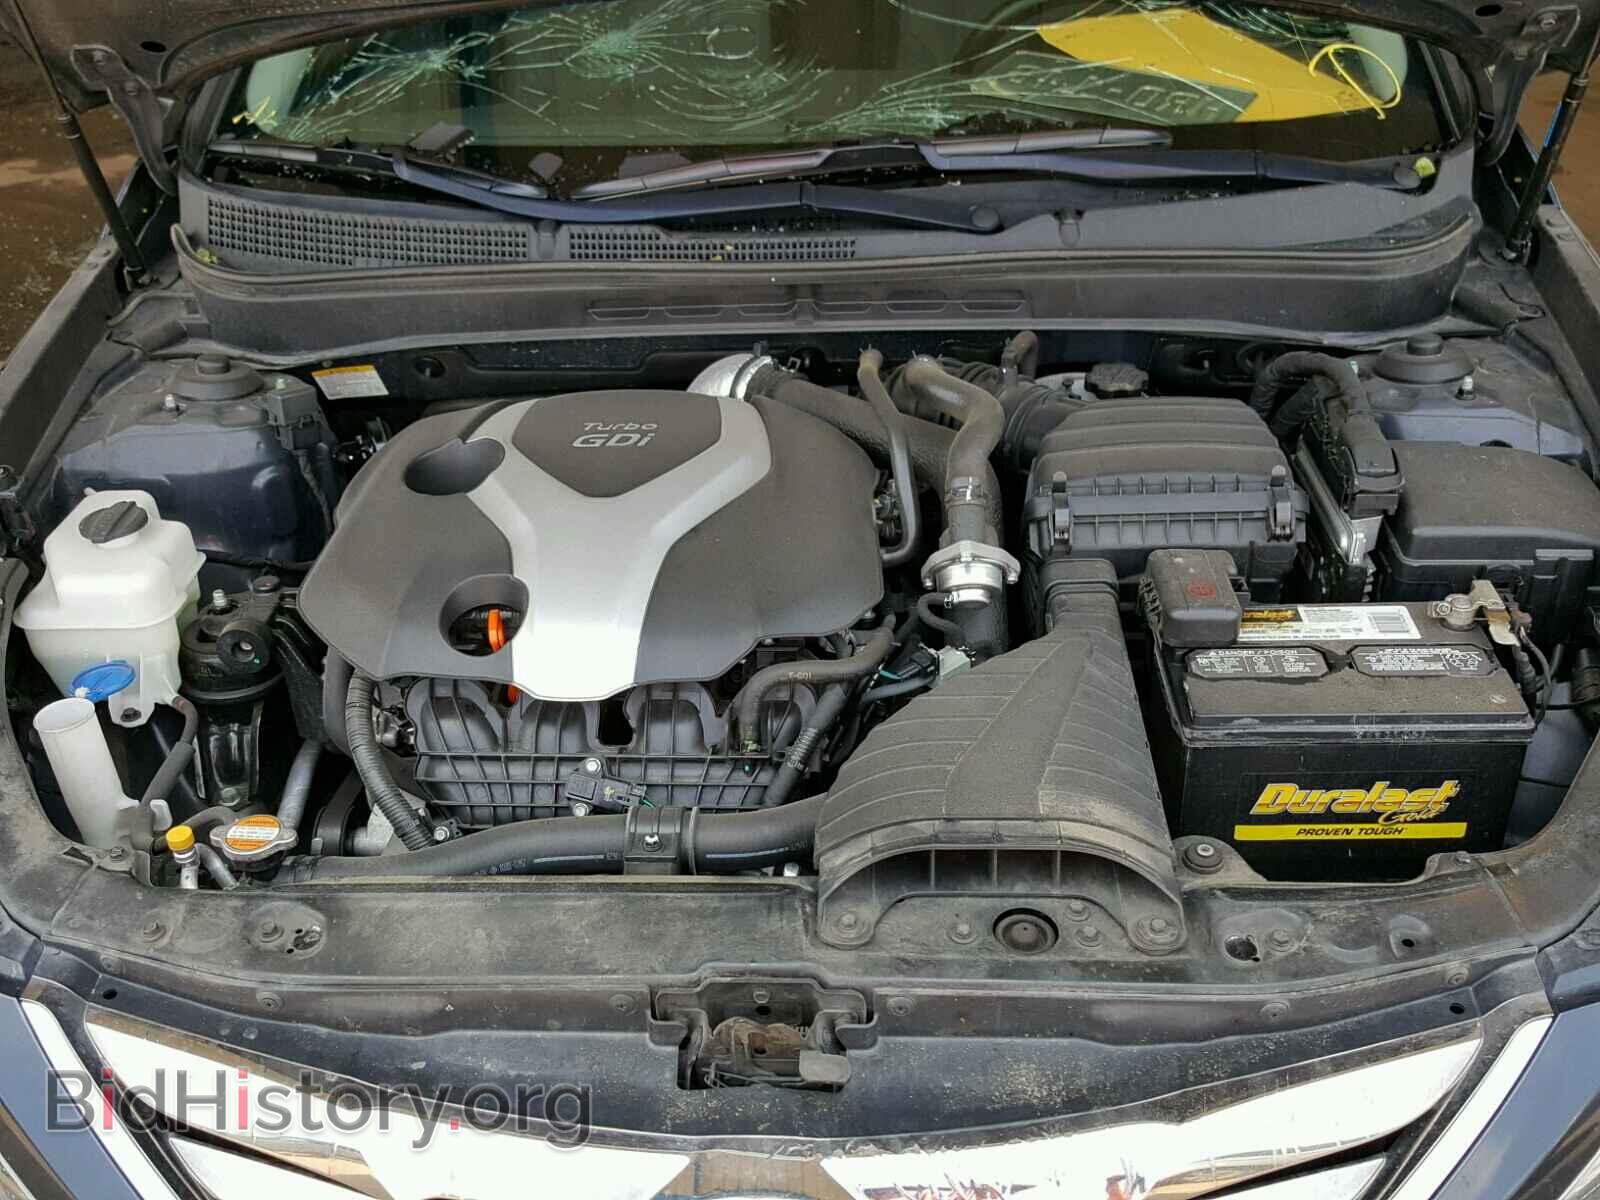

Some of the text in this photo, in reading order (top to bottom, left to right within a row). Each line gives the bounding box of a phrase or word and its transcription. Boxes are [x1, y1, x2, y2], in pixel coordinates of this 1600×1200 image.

[583, 422, 658, 431] Turbo
[572, 433, 656, 448] GDi
[1250, 780, 1460, 815] Duralast
[1378, 806, 1441, 825] Gold
[1296, 827, 1353, 836] PROVEN
